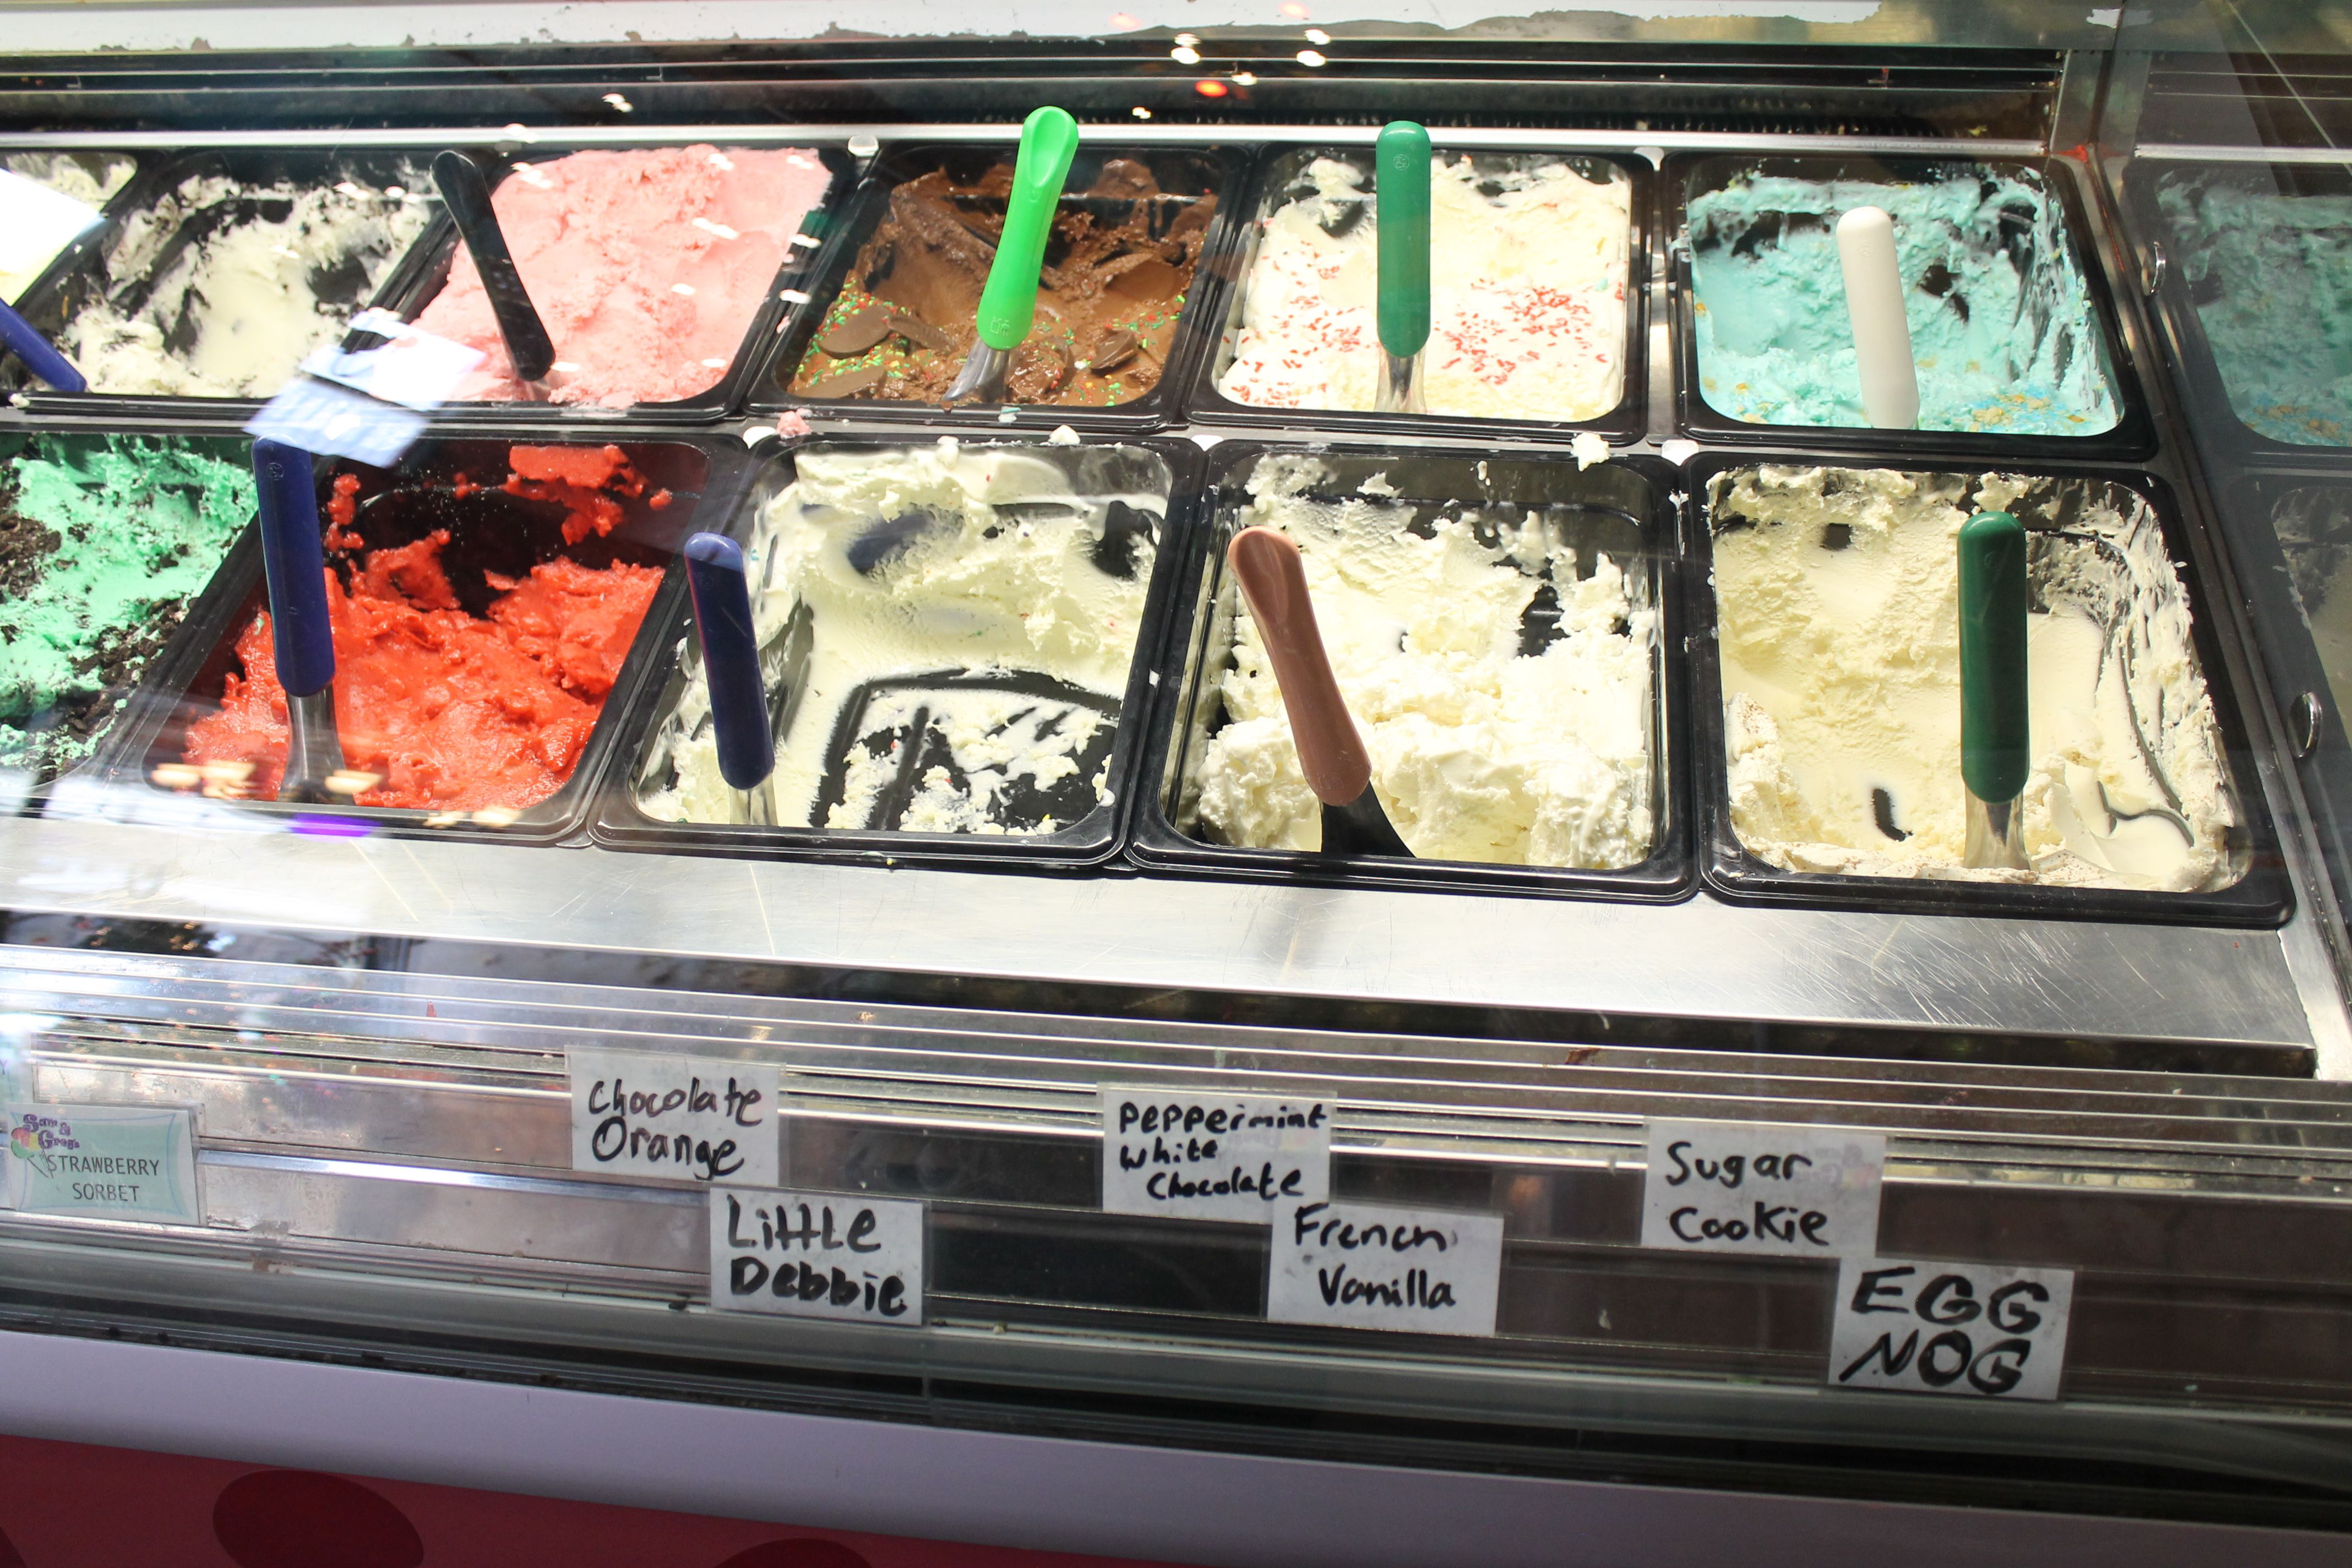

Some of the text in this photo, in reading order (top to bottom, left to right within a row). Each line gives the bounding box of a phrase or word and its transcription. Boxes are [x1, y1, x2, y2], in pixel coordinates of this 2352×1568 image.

[23, 1114, 58, 1132] Sam
[588, 1077, 763, 1126] Chocolate
[47, 1155, 160, 1176] STRAWBERRY
[592, 1117, 744, 1180] Orange
[1666, 1142, 1812, 1189] Sugar
[73, 1183, 140, 1202] SORBET
[730, 1256, 908, 1317] Debbie
[1319, 1263, 1457, 1310] Vanilla
[1851, 1266, 2050, 1335] EGG
[1838, 1329, 2032, 1395] NOG
